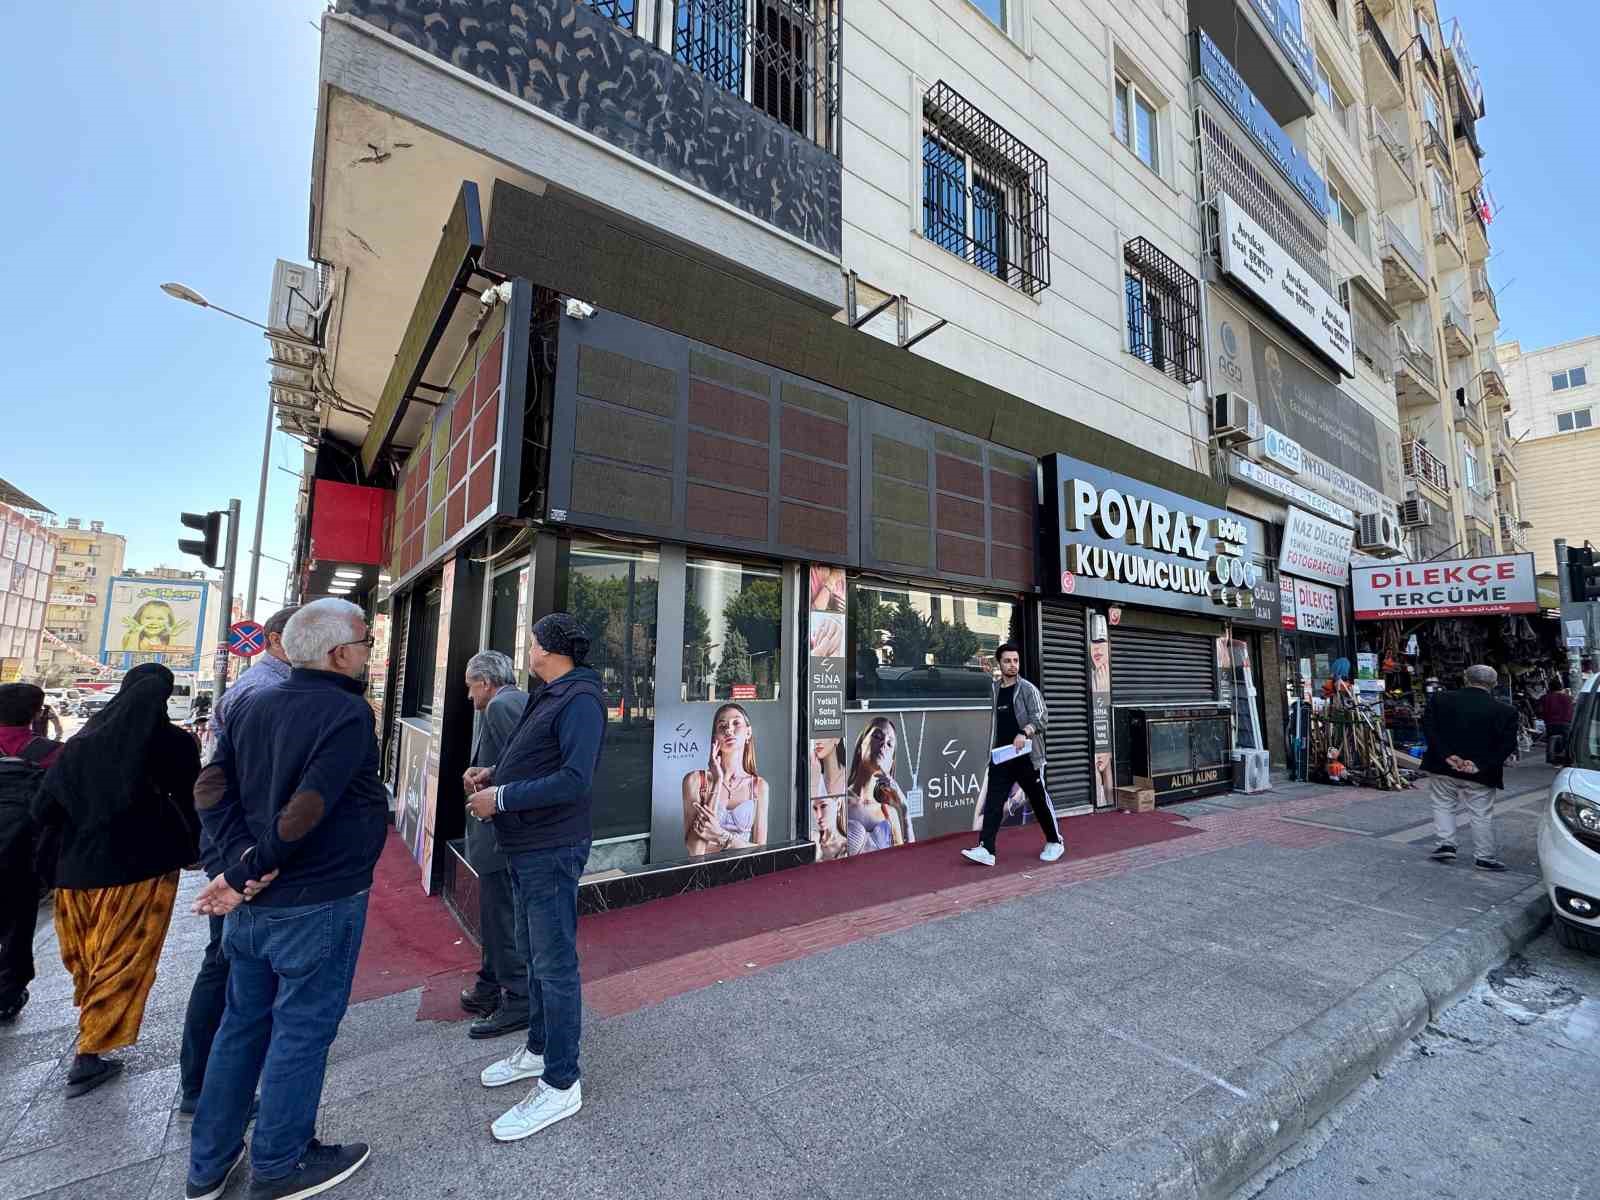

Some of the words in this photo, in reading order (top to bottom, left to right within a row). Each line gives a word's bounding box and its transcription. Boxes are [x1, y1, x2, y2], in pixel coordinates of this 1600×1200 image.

[1074, 478, 1210, 561] POYRAZ
[1292, 517, 1312, 538] NAZ
[1076, 543, 1212, 597] KUYUMCULUK
[1371, 562, 1515, 589] DİLEKÇE
[1299, 585, 1334, 613] DİLEKÇE
[1380, 587, 1507, 607] TERCÜME
[1302, 613, 1334, 631] TERCÜME
[927, 772, 981, 799] SİNA
[1171, 774, 1194, 788] ALTIN
[934, 797, 976, 809] PIRLANTA
